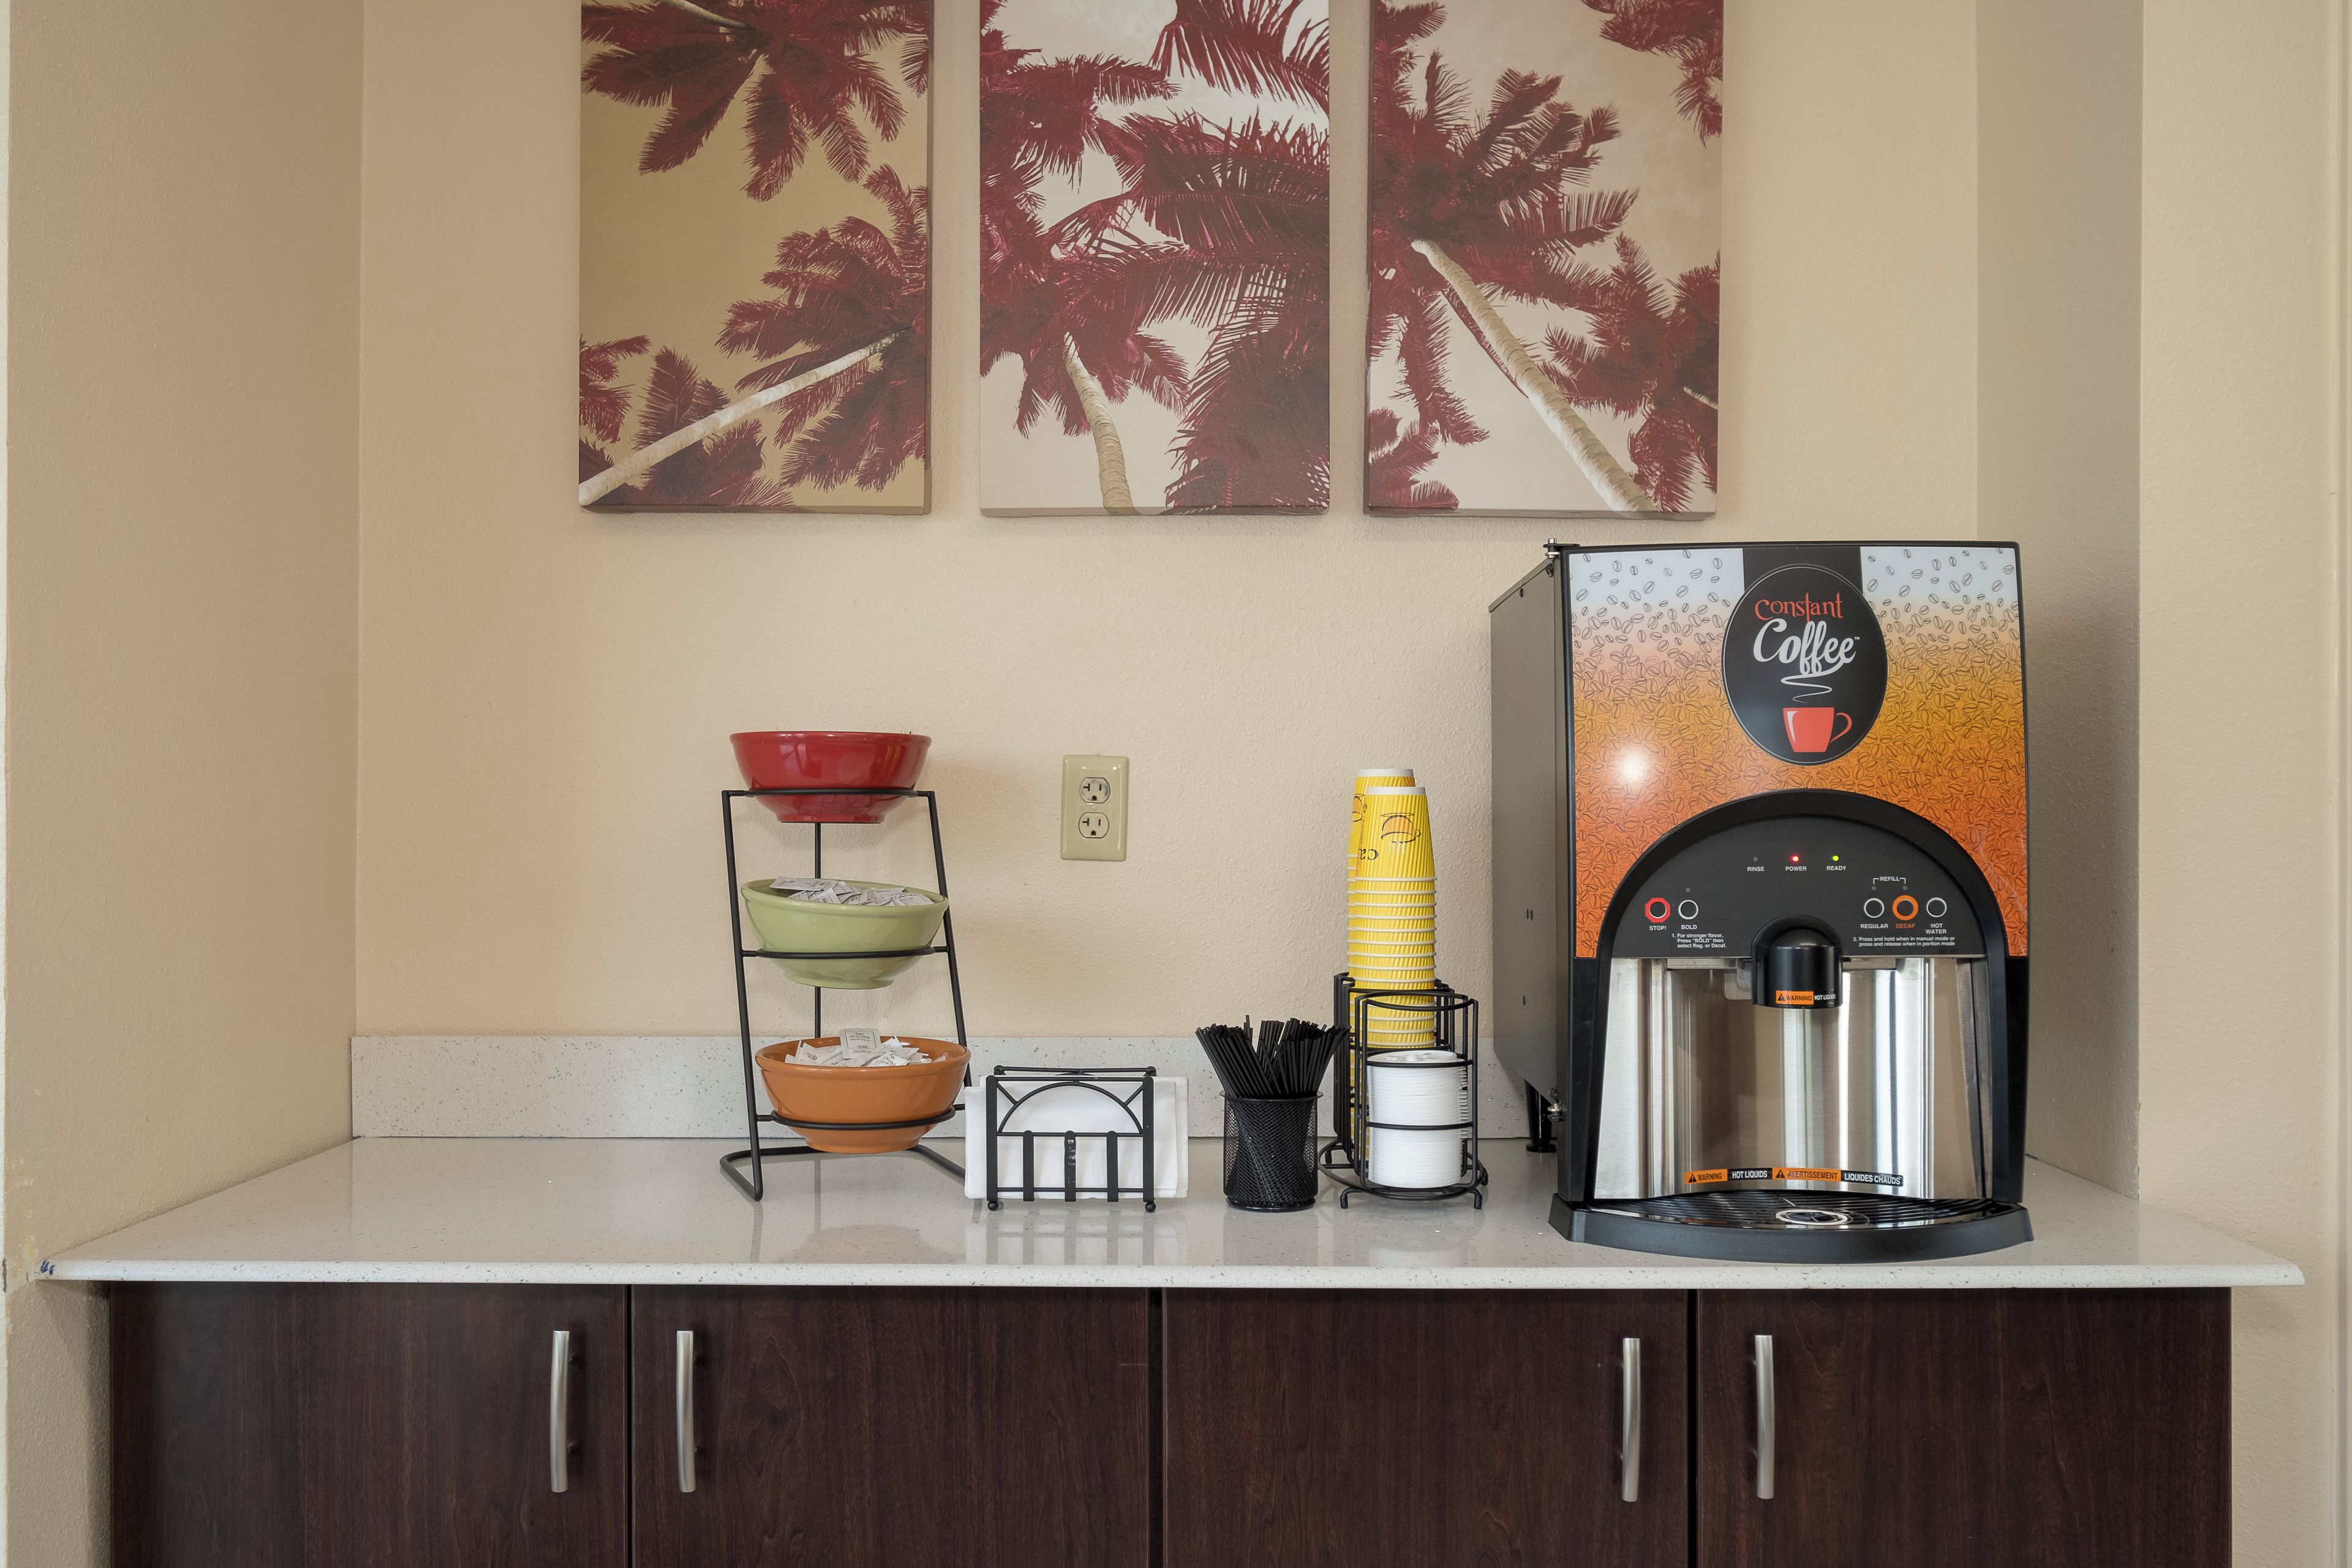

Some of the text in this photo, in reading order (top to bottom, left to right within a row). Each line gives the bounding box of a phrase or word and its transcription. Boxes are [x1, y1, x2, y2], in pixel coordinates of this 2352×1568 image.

[1755, 592, 1844, 622] Constant
[1754, 618, 1856, 674] Coffee
[1697, 1172, 1722, 1181] WARNING
[1787, 1170, 1838, 1179] AVERTISSEMENT
[1844, 1173, 1874, 1183] LIQUIDES
[1874, 1175, 1901, 1185] CHAUDS
